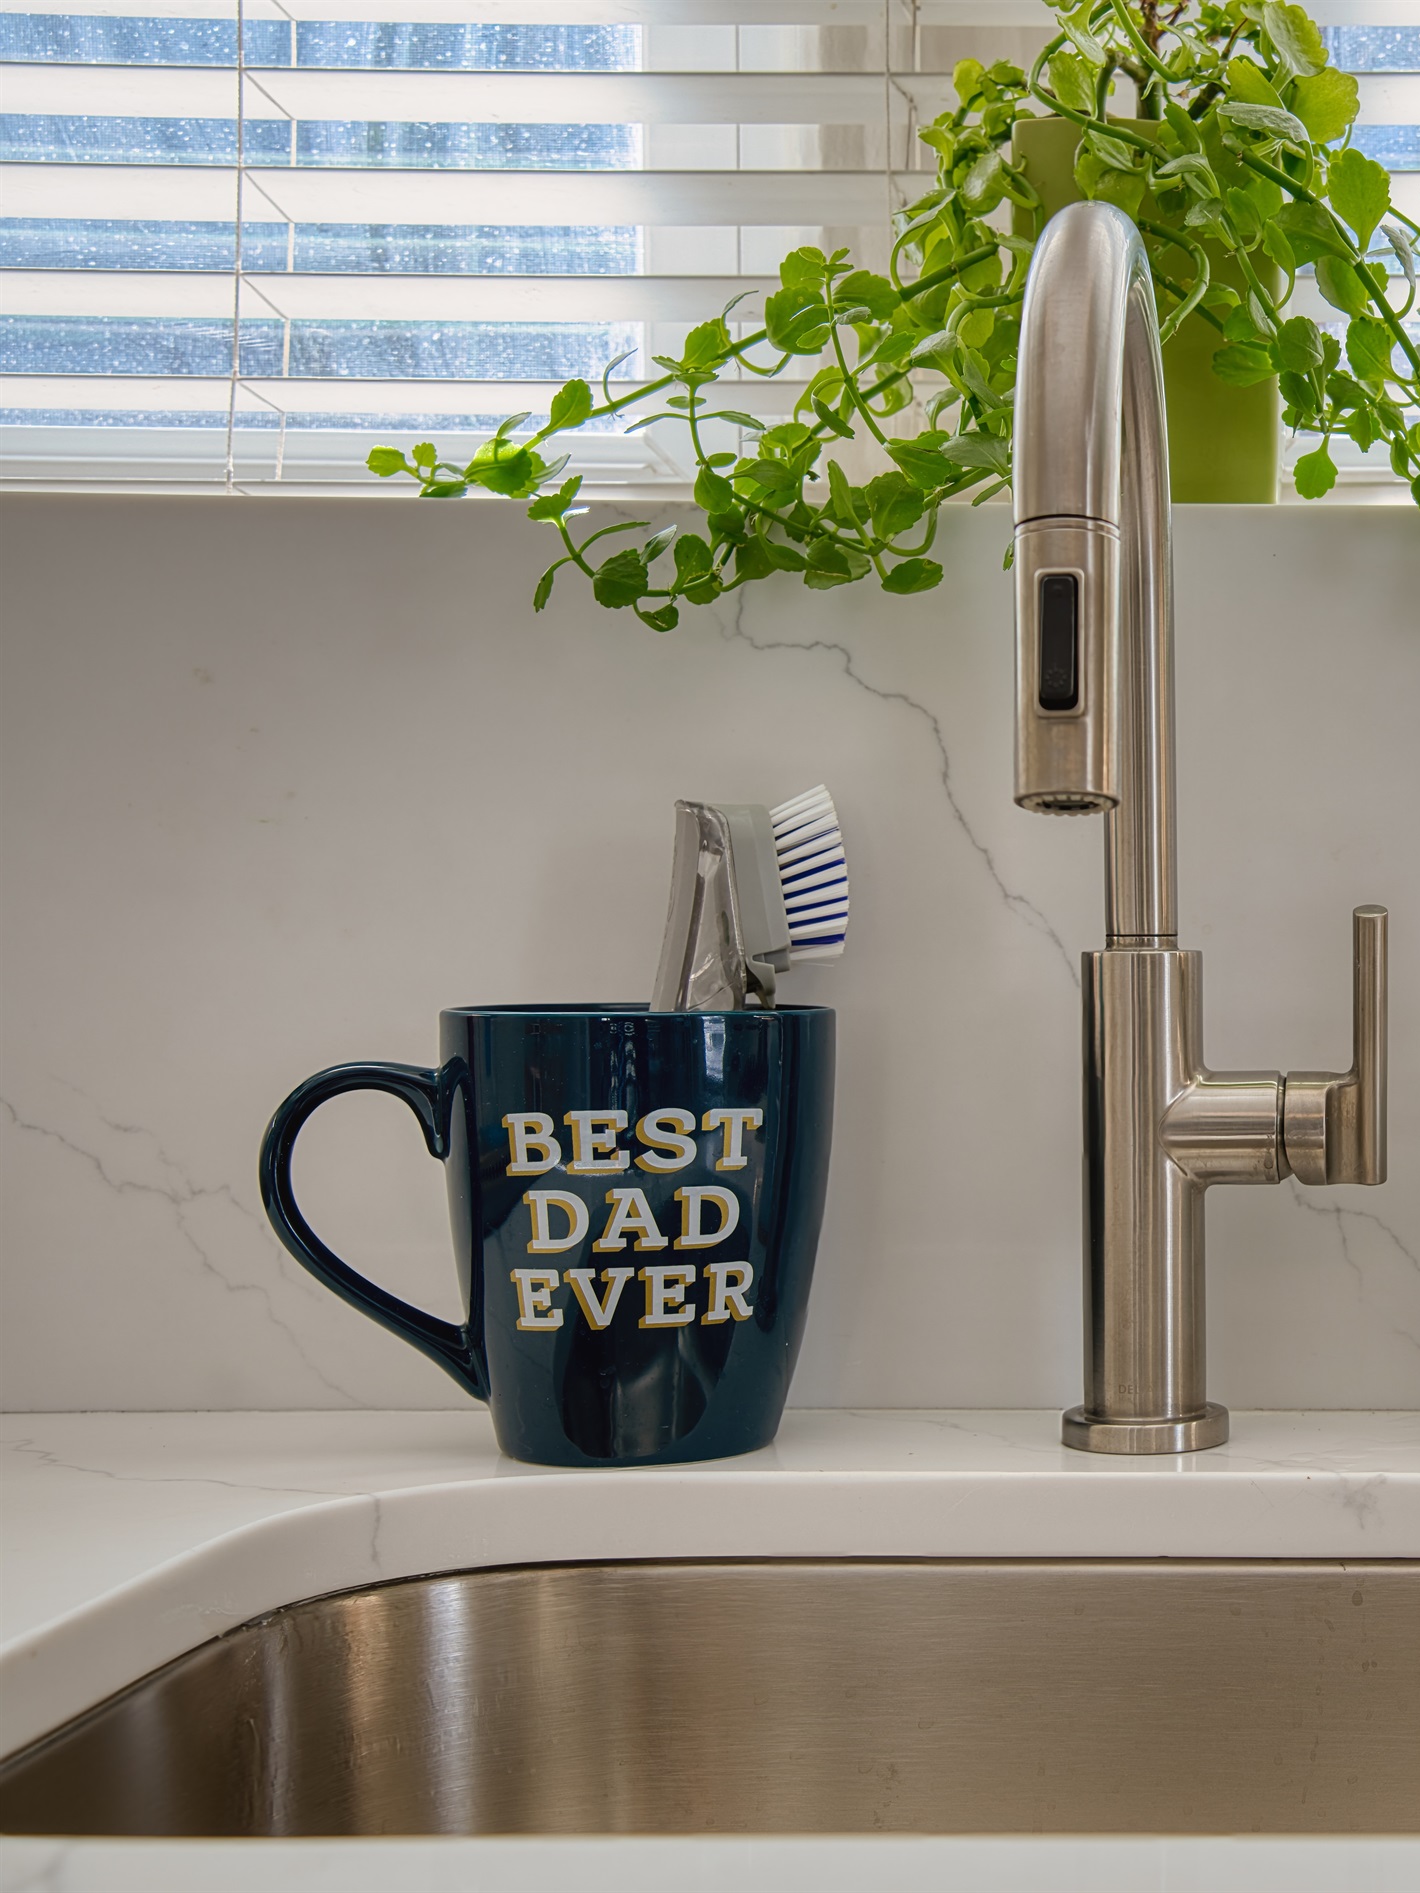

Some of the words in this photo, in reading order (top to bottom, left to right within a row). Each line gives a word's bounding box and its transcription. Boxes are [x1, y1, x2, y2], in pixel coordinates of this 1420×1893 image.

[502, 1107, 764, 1178] BEST
[522, 1185, 740, 1254] DAD
[509, 1260, 754, 1332] EVER
[1118, 1384, 1154, 1395] DELA
